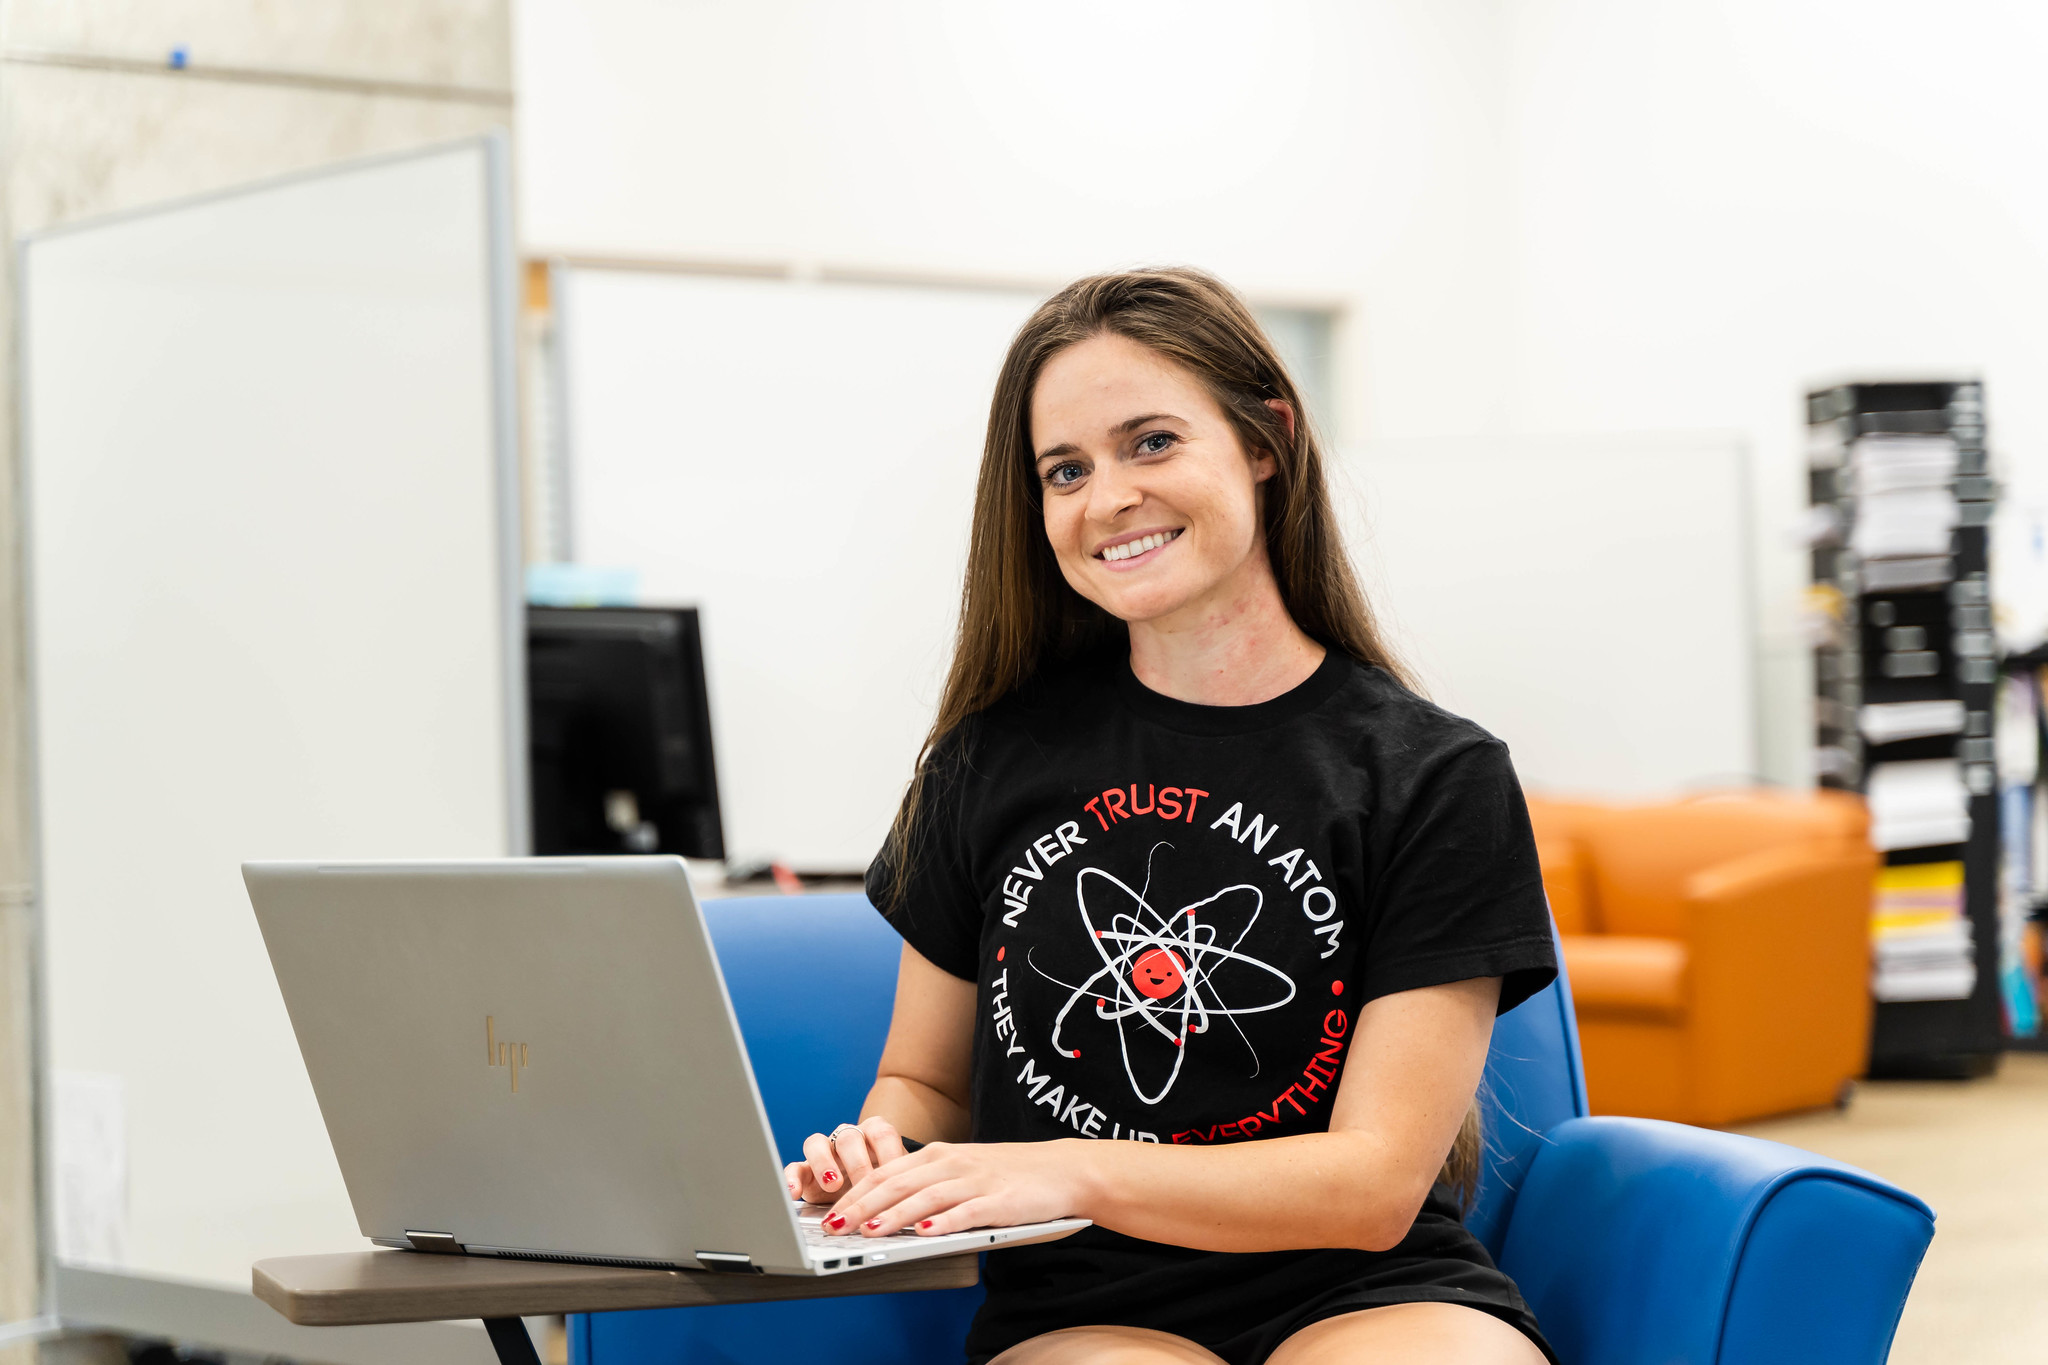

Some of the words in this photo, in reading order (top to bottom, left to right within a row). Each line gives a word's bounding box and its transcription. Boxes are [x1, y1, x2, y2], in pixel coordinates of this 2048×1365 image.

[1003, 820, 1088, 928] NEVER
[1084, 783, 1210, 832] TRUST
[1210, 802, 1279, 855] AN
[1268, 848, 1344, 960] ATOM
[486, 1015, 528, 1094] hp
[992, 968, 1026, 1059] THEY
[1016, 1059, 1108, 1139] MAKE
